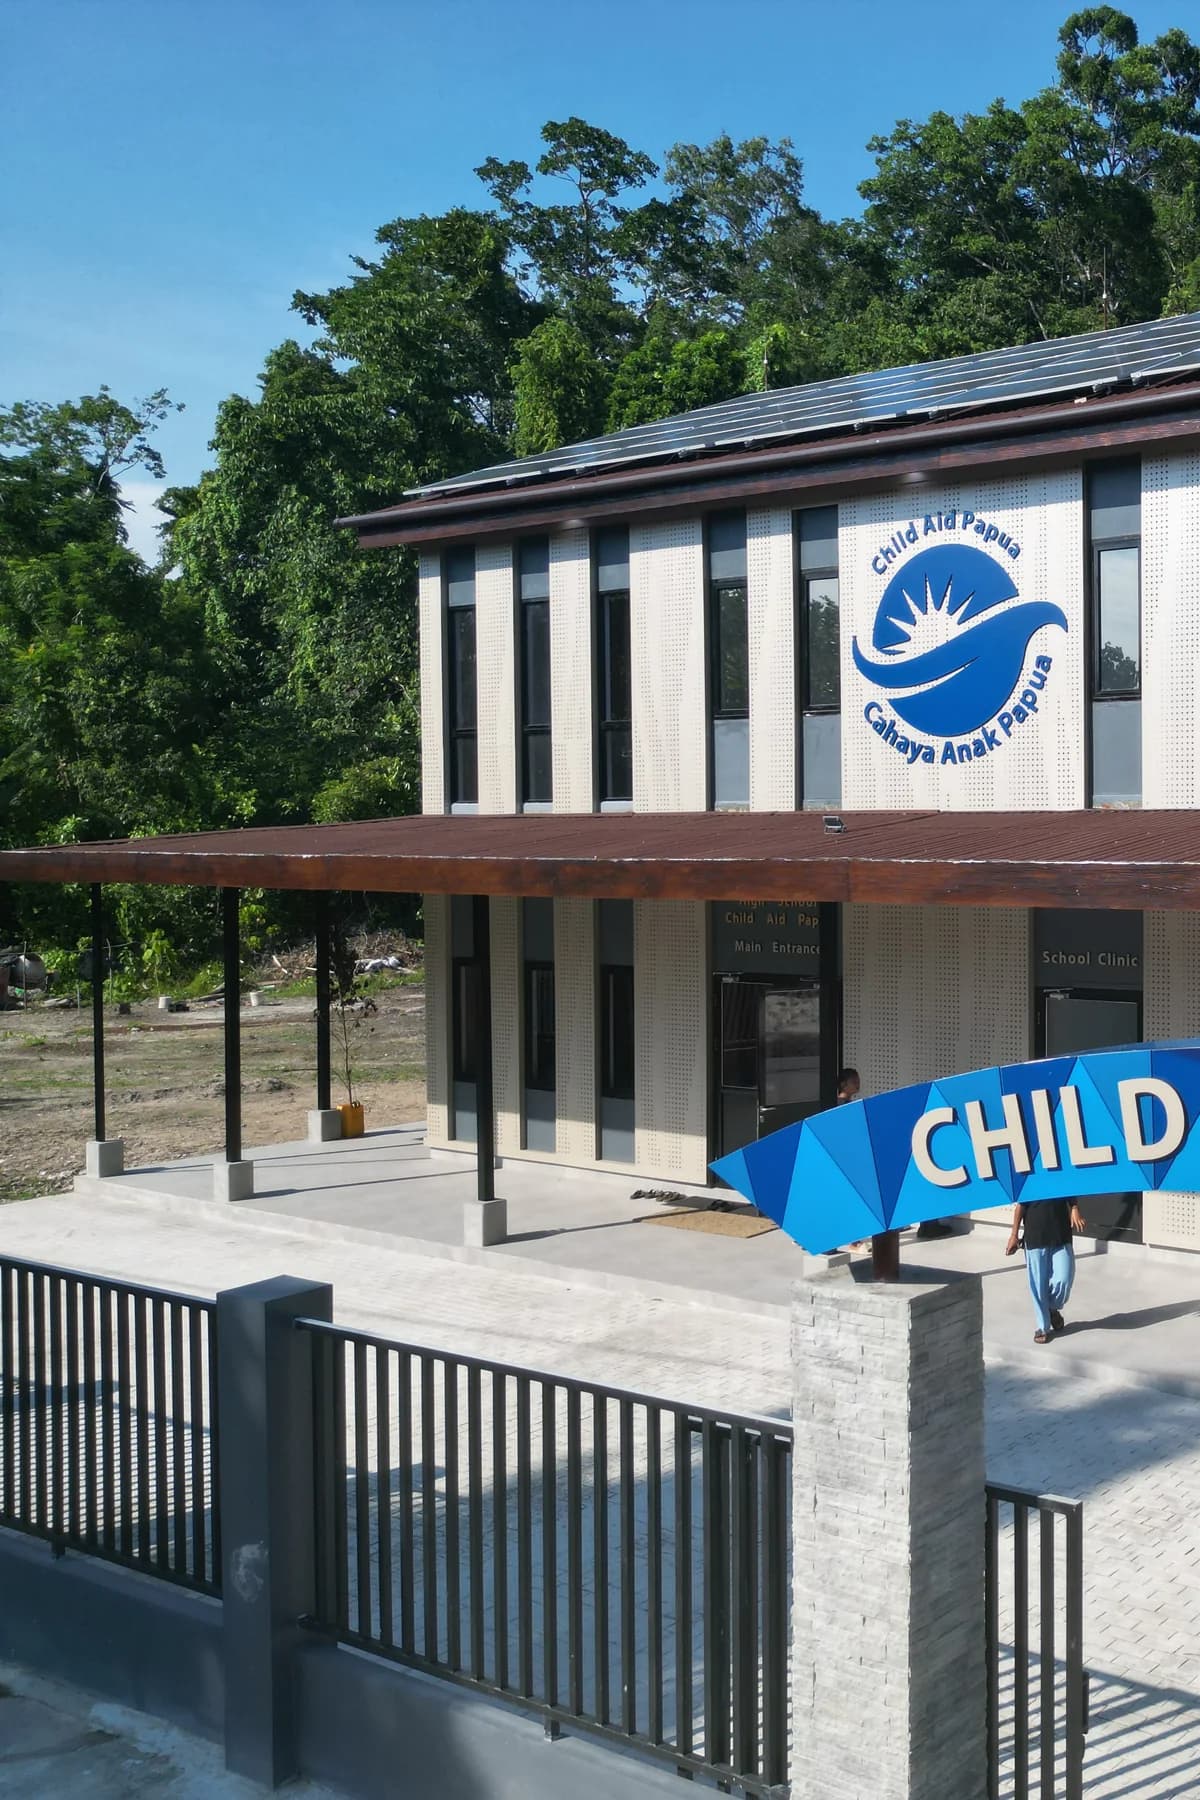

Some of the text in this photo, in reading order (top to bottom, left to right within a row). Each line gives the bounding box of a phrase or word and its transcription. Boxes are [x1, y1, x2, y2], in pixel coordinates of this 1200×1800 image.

[871, 510, 1021, 575] Child Aid Papua
[864, 654, 1053, 764] Cahaya Anak Papua
[725, 912, 820, 928] Child Aid Pap
[735, 940, 761, 953] Main
[1042, 951, 1138, 967] School Clinic
[911, 1077, 1187, 1189] CHILD
